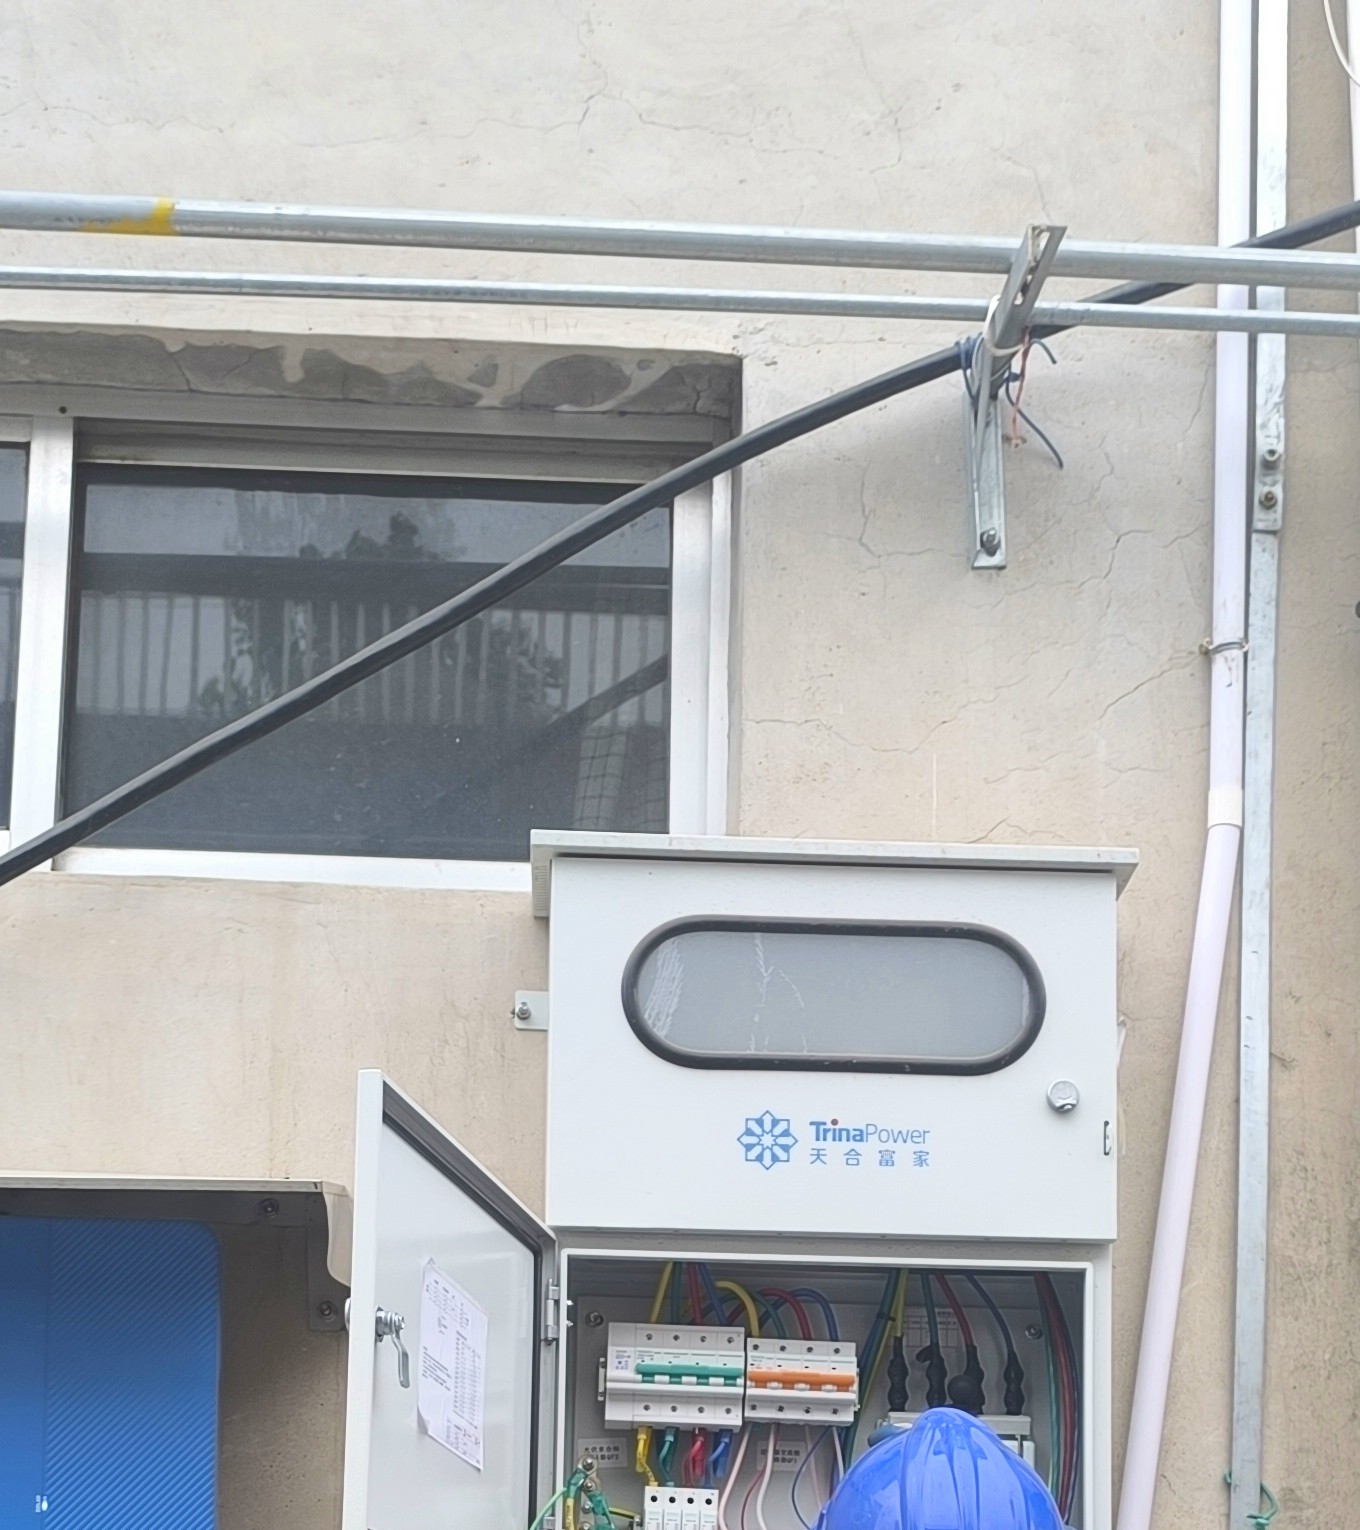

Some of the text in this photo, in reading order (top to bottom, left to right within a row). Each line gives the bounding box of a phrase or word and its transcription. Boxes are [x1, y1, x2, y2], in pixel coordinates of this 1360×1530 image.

[809, 1118, 930, 1144] TrinaPower
[809, 1148, 931, 1168] 天合富家
